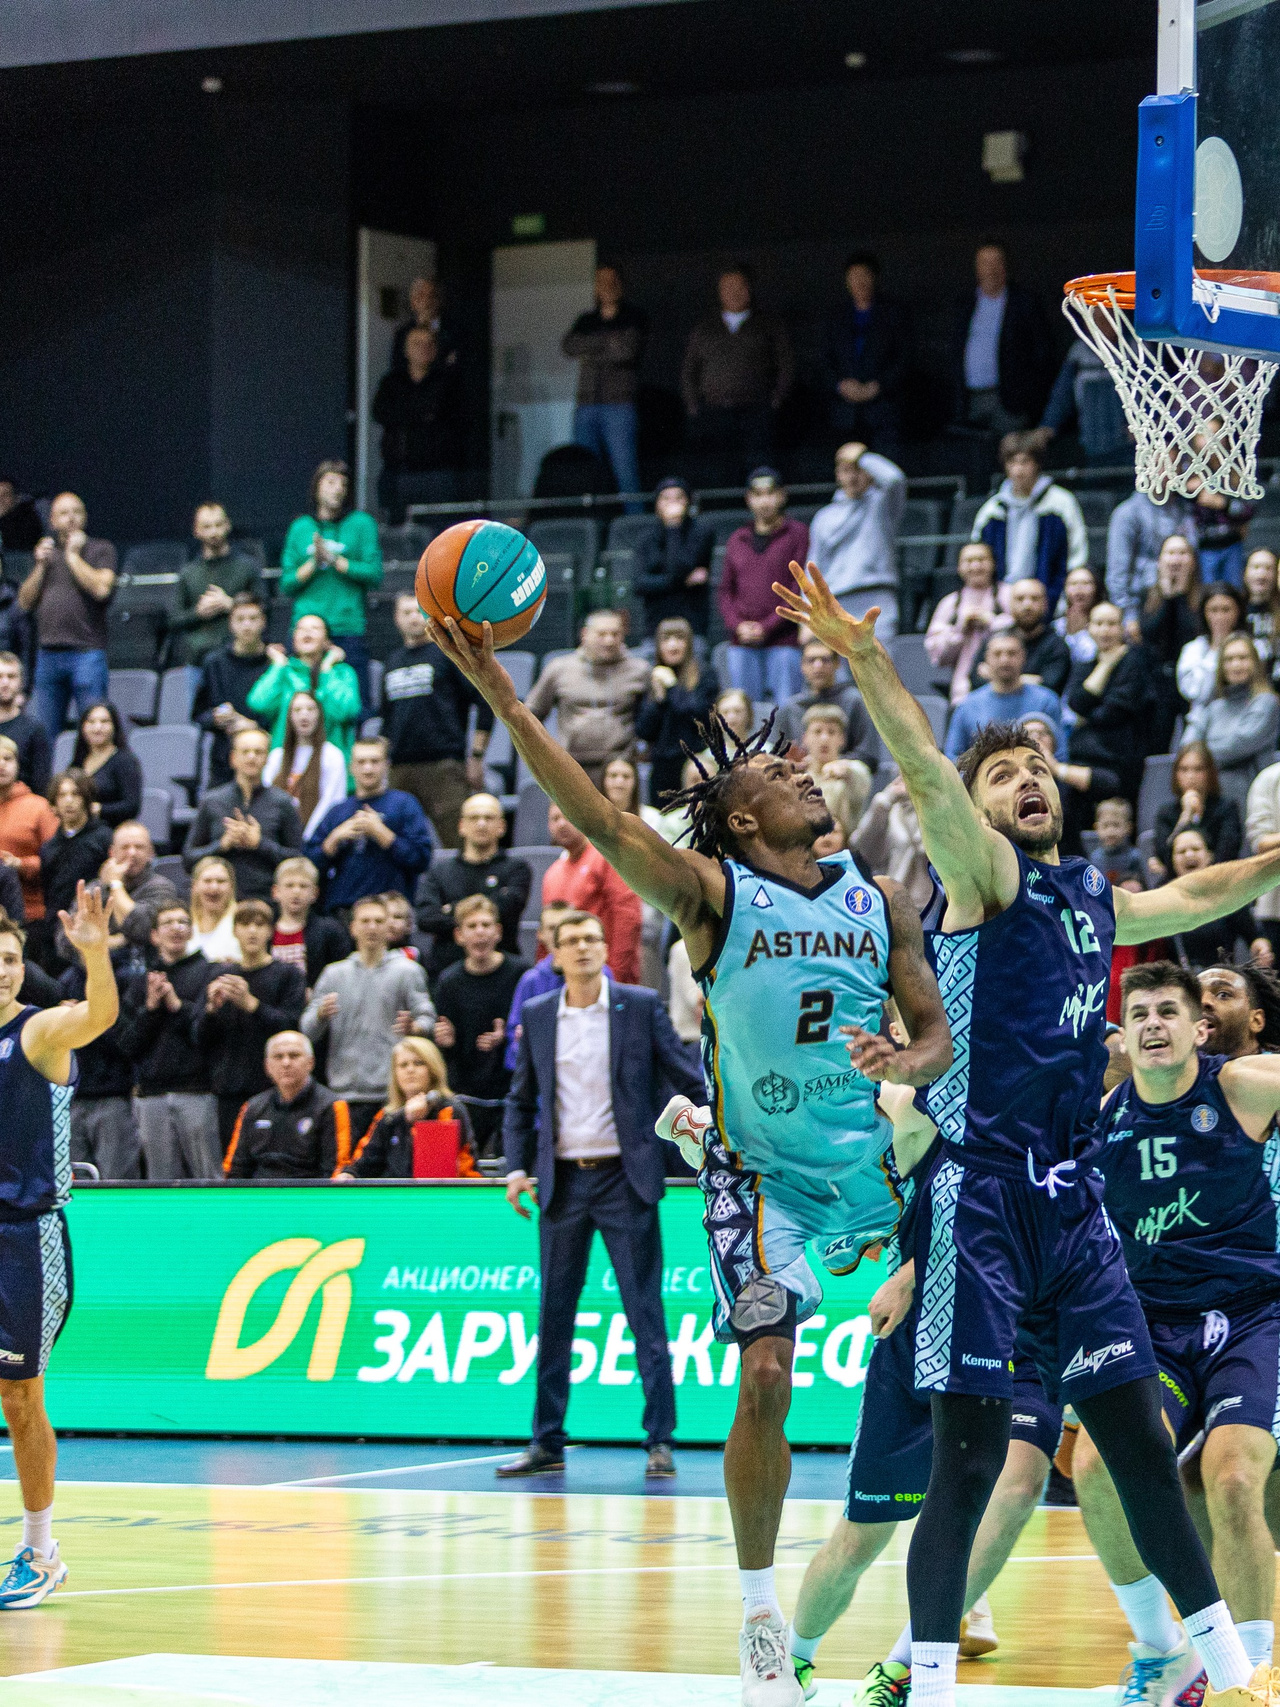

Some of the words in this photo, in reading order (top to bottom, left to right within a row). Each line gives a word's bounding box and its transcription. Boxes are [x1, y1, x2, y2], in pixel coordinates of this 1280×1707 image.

[743, 929, 880, 969] ASTANA
[1060, 908, 1101, 955] 12
[795, 988, 836, 1046] 2
[1137, 1136, 1178, 1181] 15
[382, 1265, 541, 1293] АКЦИОНЕР
[961, 1353, 1002, 1370] Kempa
[854, 1490, 891, 1504] Kempa
